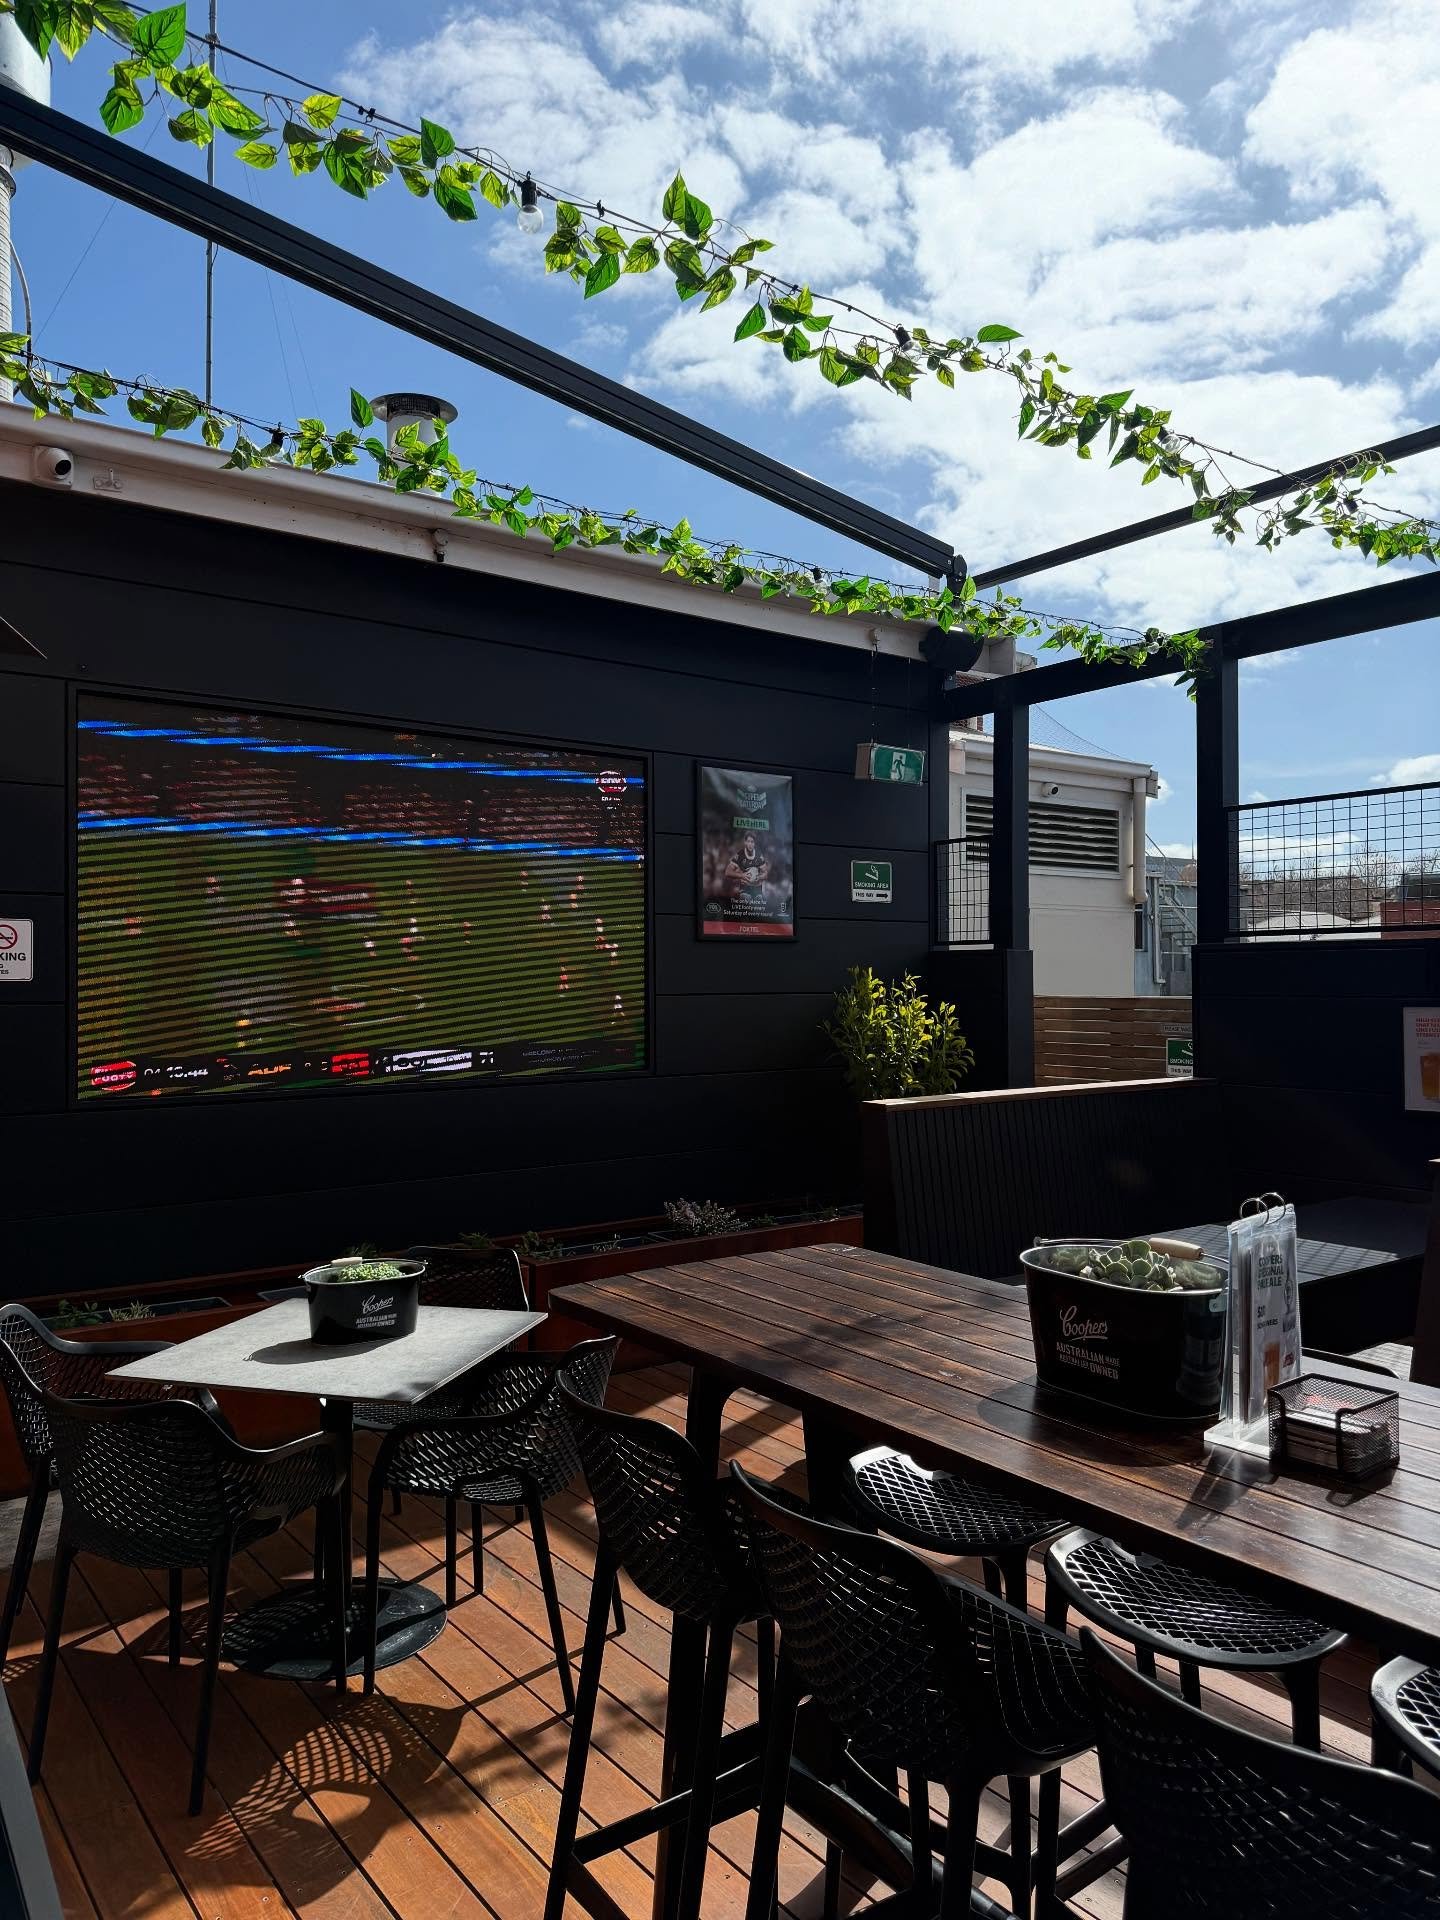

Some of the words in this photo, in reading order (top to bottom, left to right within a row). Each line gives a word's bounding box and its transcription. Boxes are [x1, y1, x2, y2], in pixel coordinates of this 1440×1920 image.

[362, 1294, 394, 1314] Coopers
[355, 1314, 387, 1325] AUSTRALIAN
[1059, 1305, 1108, 1340] Coopers
[1056, 1341, 1104, 1365] AUSTRALIAN
[1089, 1362, 1119, 1380] OWNED
